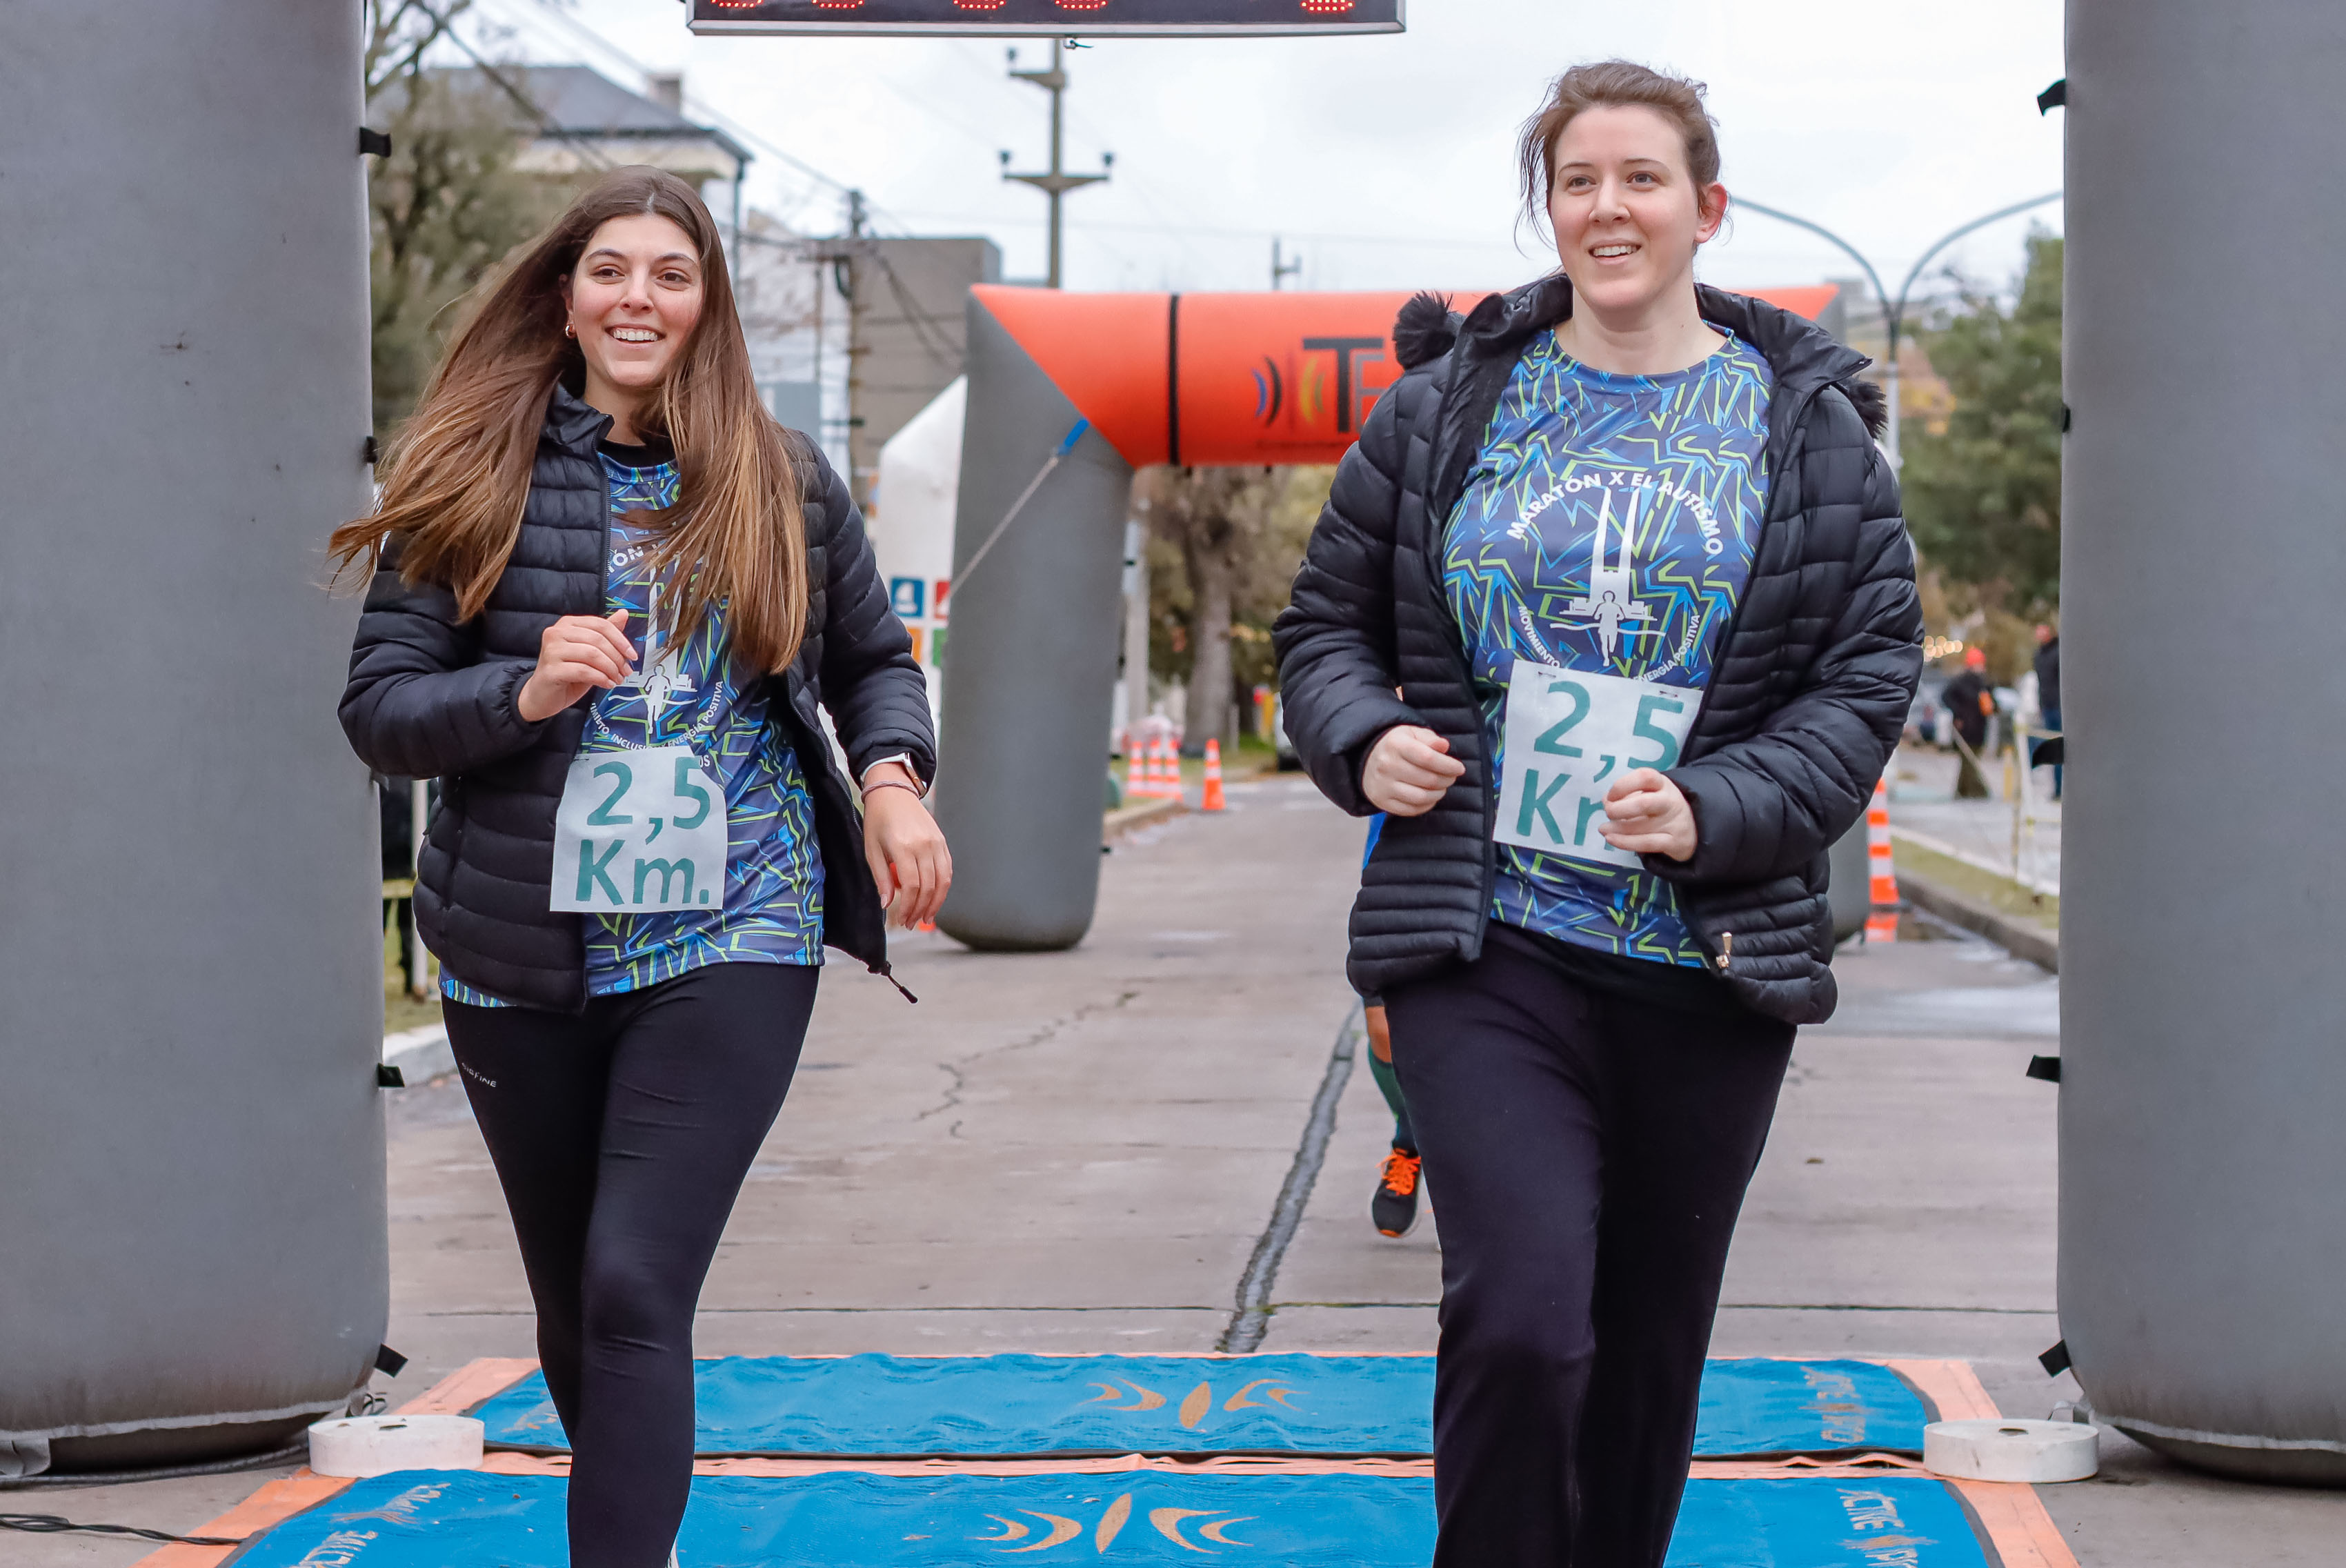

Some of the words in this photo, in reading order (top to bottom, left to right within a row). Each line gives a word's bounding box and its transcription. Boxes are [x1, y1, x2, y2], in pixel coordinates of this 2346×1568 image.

[1507, 474, 1602, 540] MARATÓN
[1609, 471, 1625, 486] X
[1631, 472, 1653, 489] EL
[1657, 481, 1724, 555] AUTISMO
[1518, 606, 1560, 668] MOVIMIENTO
[1673, 614, 1700, 661] POSITIVA
[702, 680, 724, 724] POSITIVA
[1533, 681, 1685, 783] 2,5
[587, 756, 710, 845] 2,5
[575, 839, 709, 906] Km.
